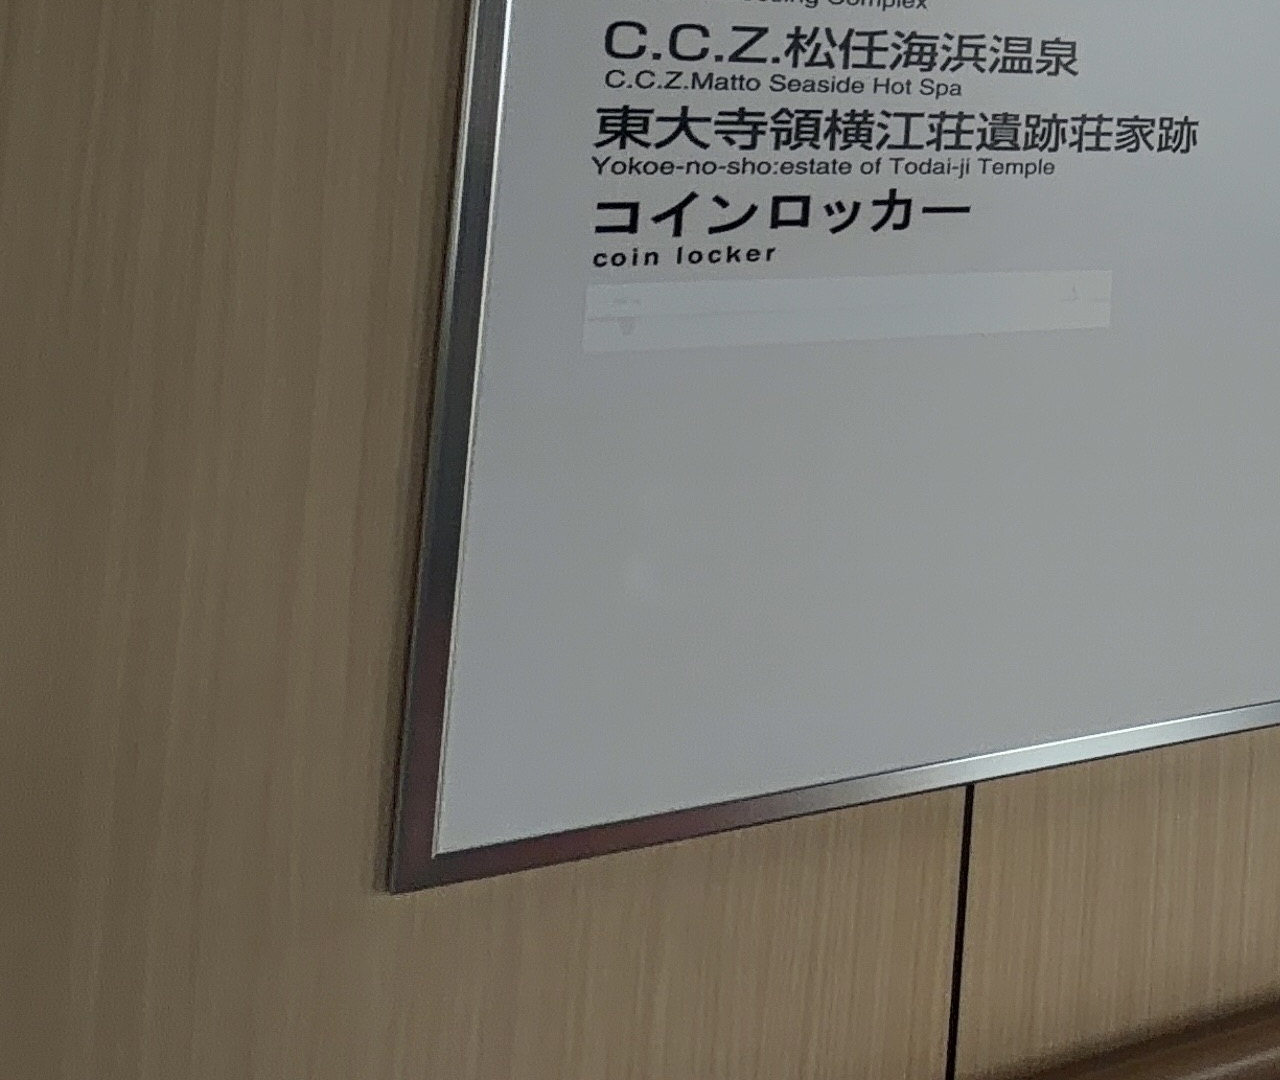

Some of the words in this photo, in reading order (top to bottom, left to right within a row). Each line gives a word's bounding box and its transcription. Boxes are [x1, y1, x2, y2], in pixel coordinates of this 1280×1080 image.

[604, 20, 1079, 77] C.C.Z.松任海浜温泉
[768, 73, 865, 94] Seaside
[872, 77, 912, 95] Hot
[919, 77, 962, 100] Spa
[593, 104, 1199, 154] 東大寺領横江荘遺跡荘家跡
[859, 156, 882, 175] of
[888, 157, 970, 179] Todai-ji
[977, 157, 1056, 179] Temple
[594, 187, 971, 238] コインロッカー
[592, 247, 659, 268] coin
[676, 245, 776, 265] locker
